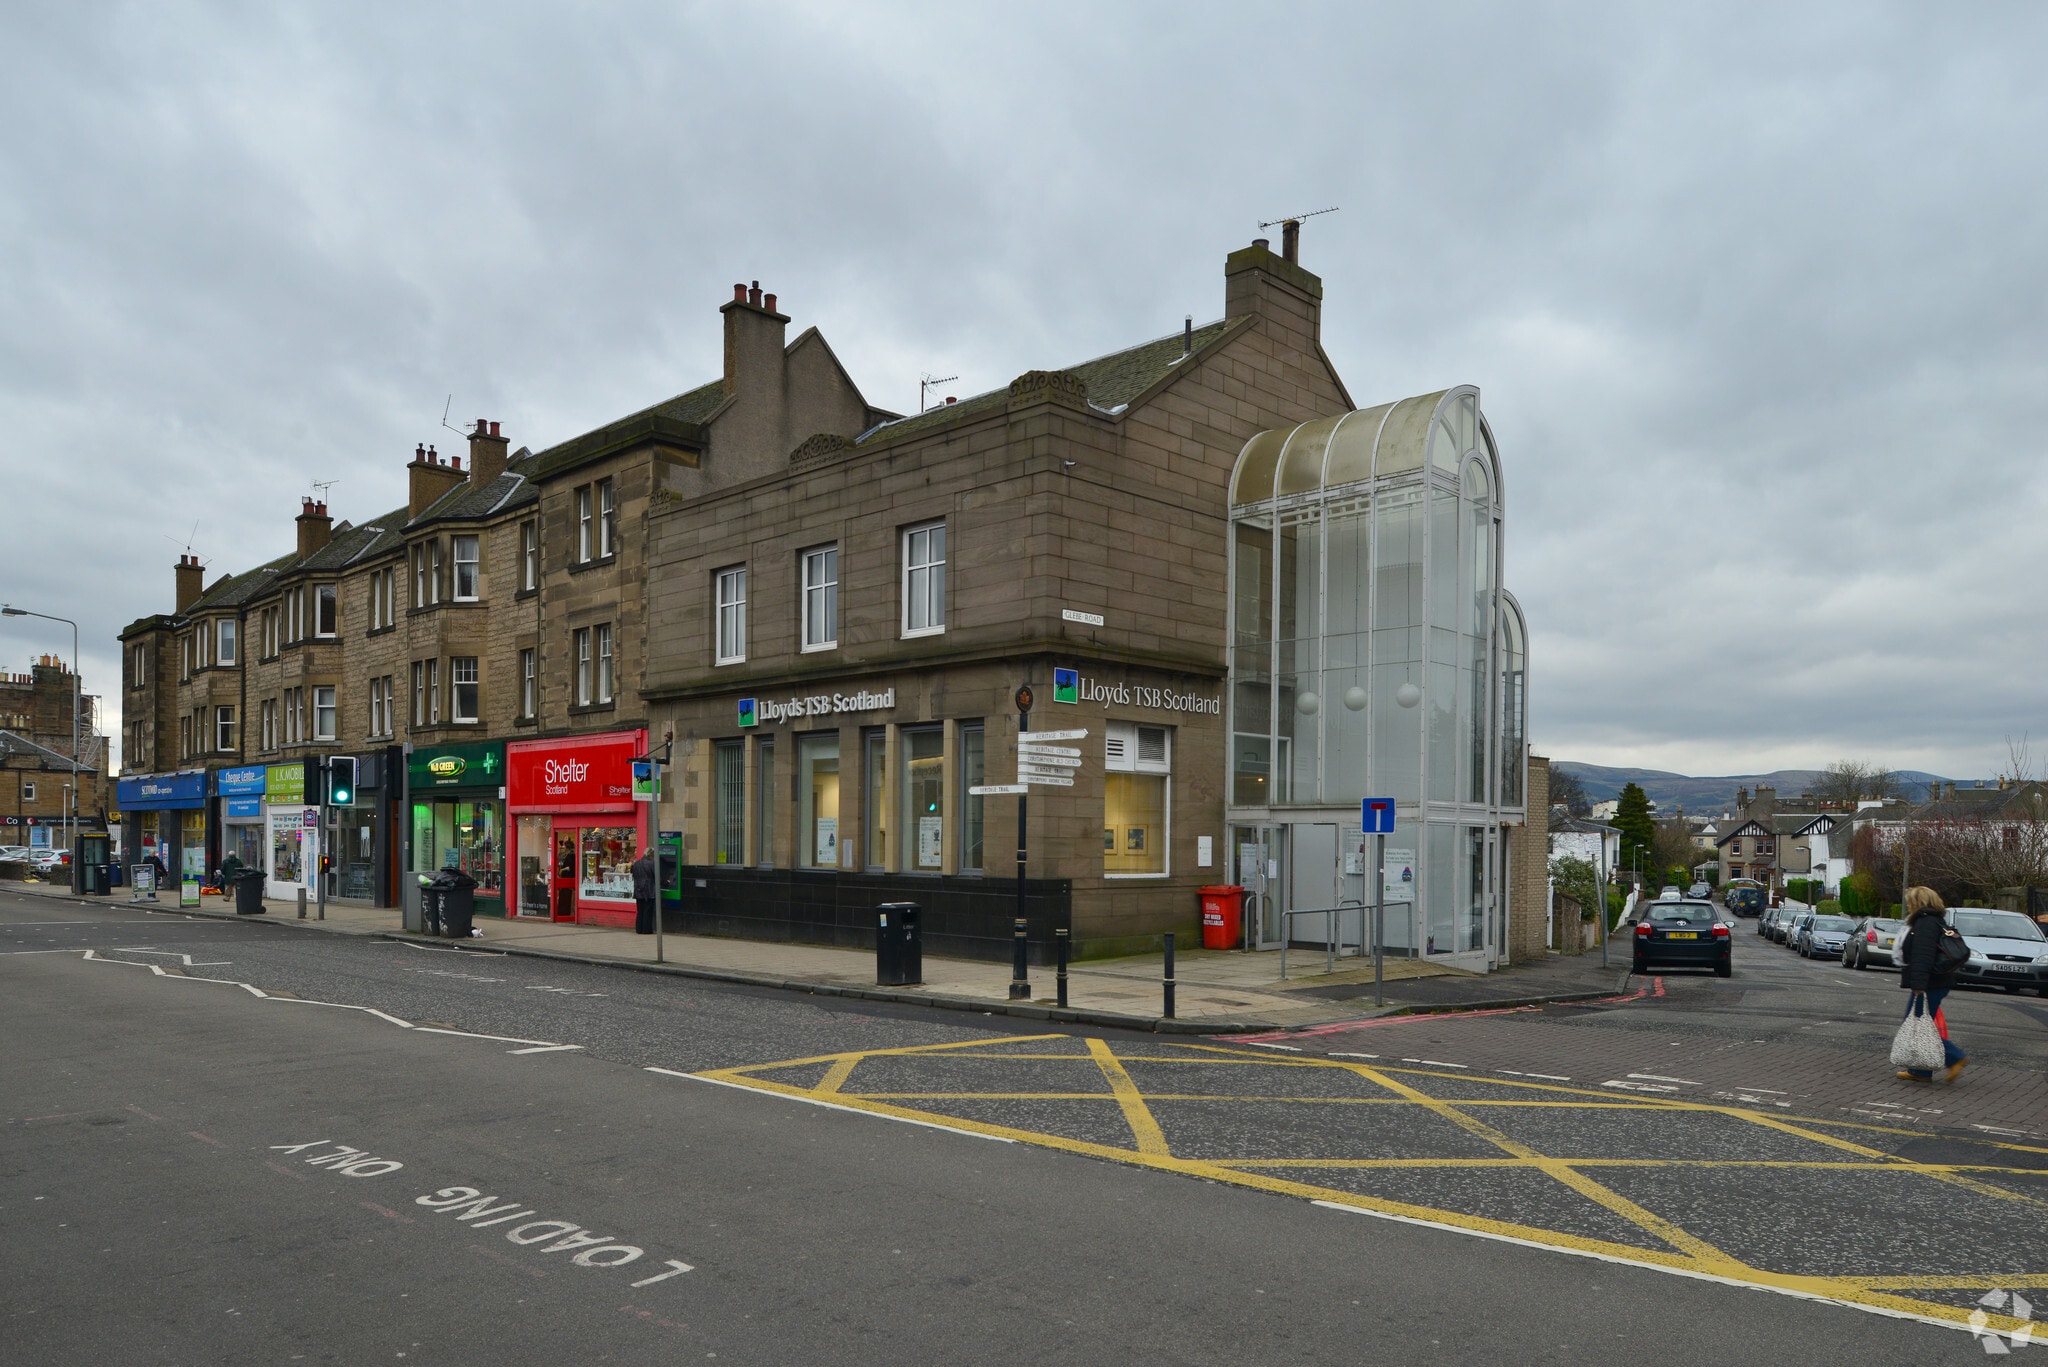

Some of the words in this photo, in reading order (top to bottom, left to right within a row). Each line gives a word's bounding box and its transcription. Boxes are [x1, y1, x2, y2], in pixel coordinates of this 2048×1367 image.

[1065, 610, 1082, 621] GLEBE
[1084, 614, 1102, 624] ROAD
[759, 698, 804, 725] Lloyds
[804, 695, 832, 716] TSB
[832, 687, 896, 713] Scotland
[1080, 677, 1130, 709] Lloyds
[1133, 686, 1160, 708] TSB
[1163, 688, 1220, 715] Scotland
[225, 771, 241, 785] Cheque
[241, 770, 255, 782] Centre
[544, 757, 590, 785] Shelter
[545, 784, 568, 796] Scotland
[609, 785, 631, 794] Shelter
[269, 1139, 404, 1178] ONLY
[415, 1186, 695, 1288] LOADING
